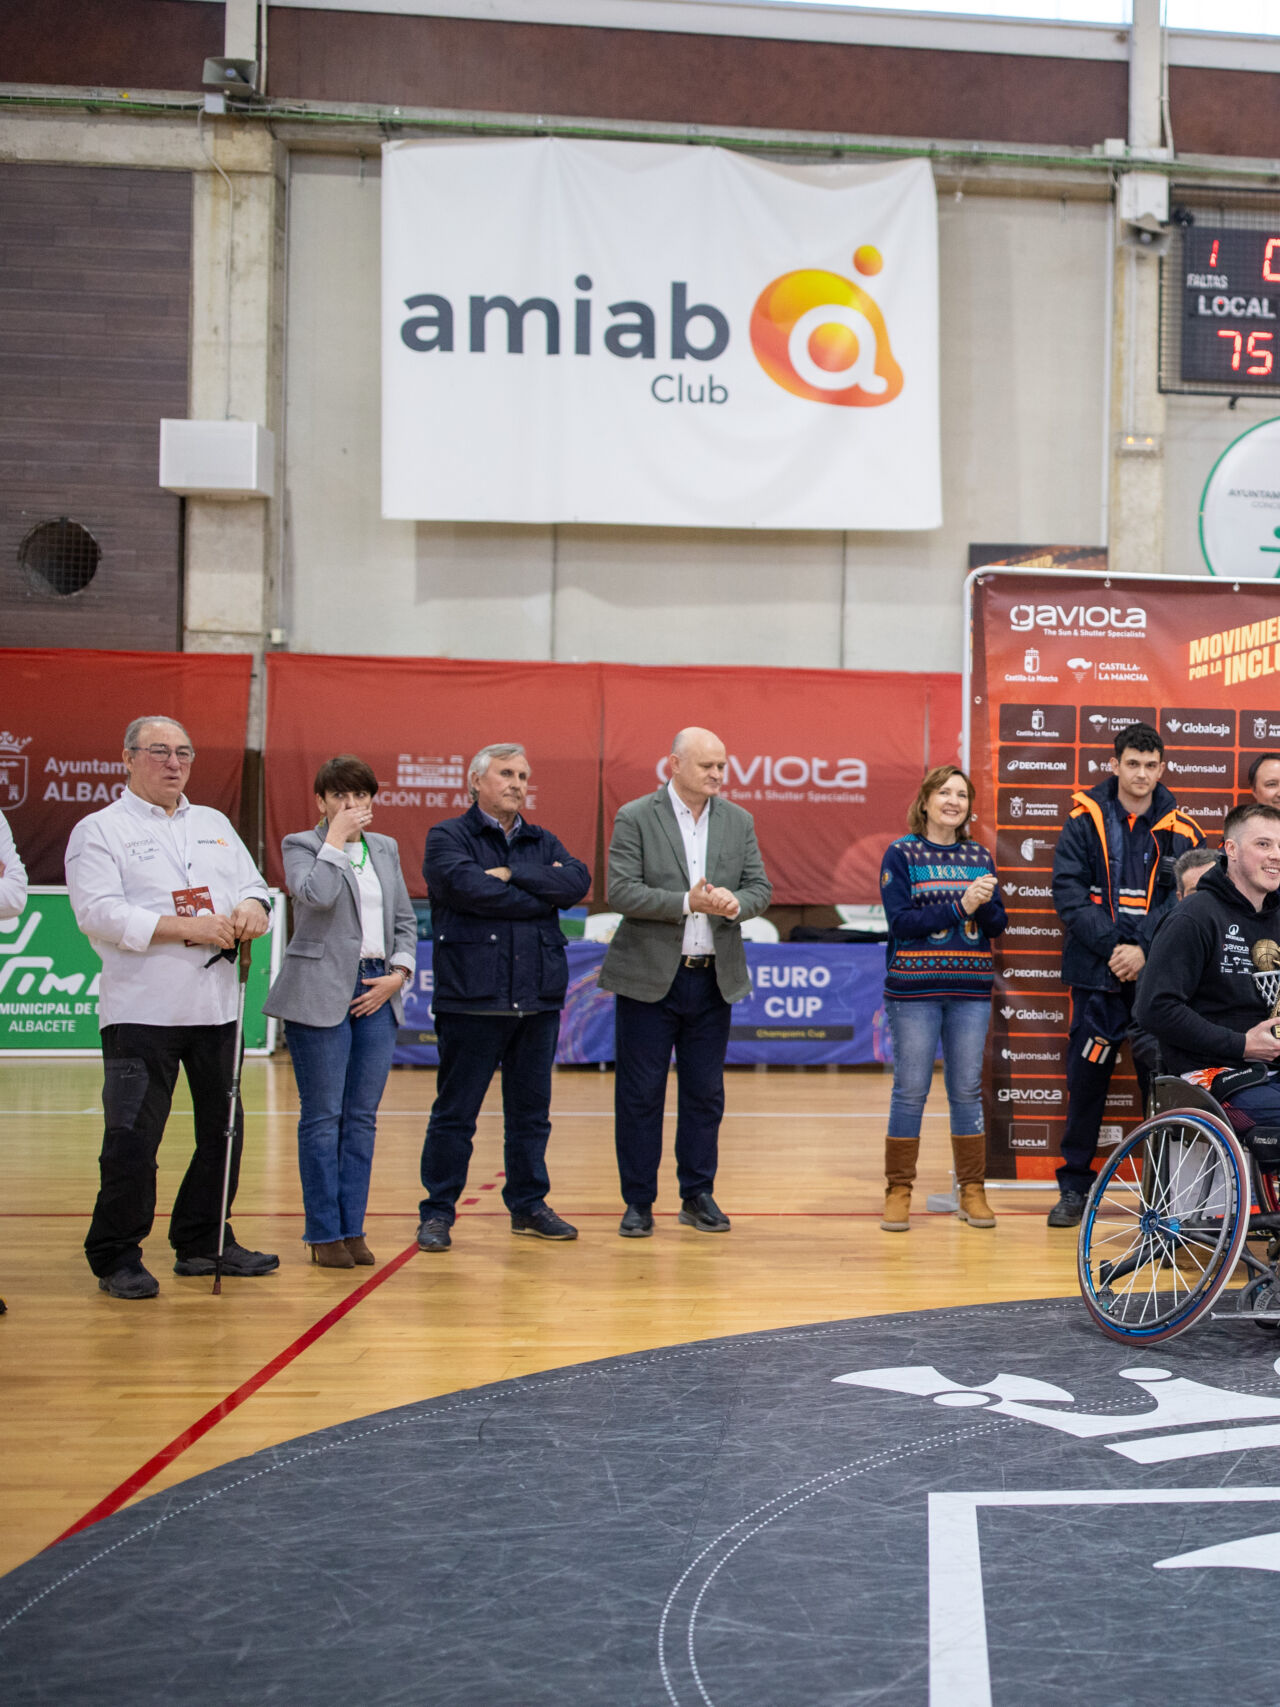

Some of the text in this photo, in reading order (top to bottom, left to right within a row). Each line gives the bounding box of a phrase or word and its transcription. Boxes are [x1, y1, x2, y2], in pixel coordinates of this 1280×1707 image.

[1210, 239, 1220, 268] 1
[1186, 272, 1229, 290] FALTAS
[1198, 295, 1277, 320] LOCAL
[400, 274, 731, 362] amiab
[1217, 329, 1274, 376] 75
[650, 373, 730, 405] Club
[1009, 604, 1147, 631] gaviota
[1044, 627, 1058, 637] The
[1058, 628, 1073, 638] Sun
[1080, 628, 1107, 638] Shutter
[1098, 662, 1142, 672] CASTILLA-
[1188, 660, 1223, 681] POR LA
[1036, 674, 1059, 684] Mancha
[1098, 671, 1149, 683] LA MANCHA
[1182, 722, 1231, 738] Globalcaja
[44, 757, 129, 776] Ayuntam
[43, 781, 126, 802] ALBAC
[371, 790, 421, 808] ACIÓN
[425, 793, 447, 807] DE
[730, 789, 866, 804] Sun & Shutter Specialists
[1181, 805, 1223, 817] CaixaBank
[1018, 886, 1053, 897] Globalc
[756, 965, 832, 989] EURO
[0, 1003, 92, 1015] MUNICIPAL DE
[763, 996, 824, 1019] CUP
[1015, 1009, 1065, 1023] Globalcaja
[8, 1019, 77, 1033] ALBACETE
[756, 1029, 827, 1041] Champions Cup
[997, 1088, 1063, 1101] gaviota
[1018, 1139, 1047, 1147] UCLM
